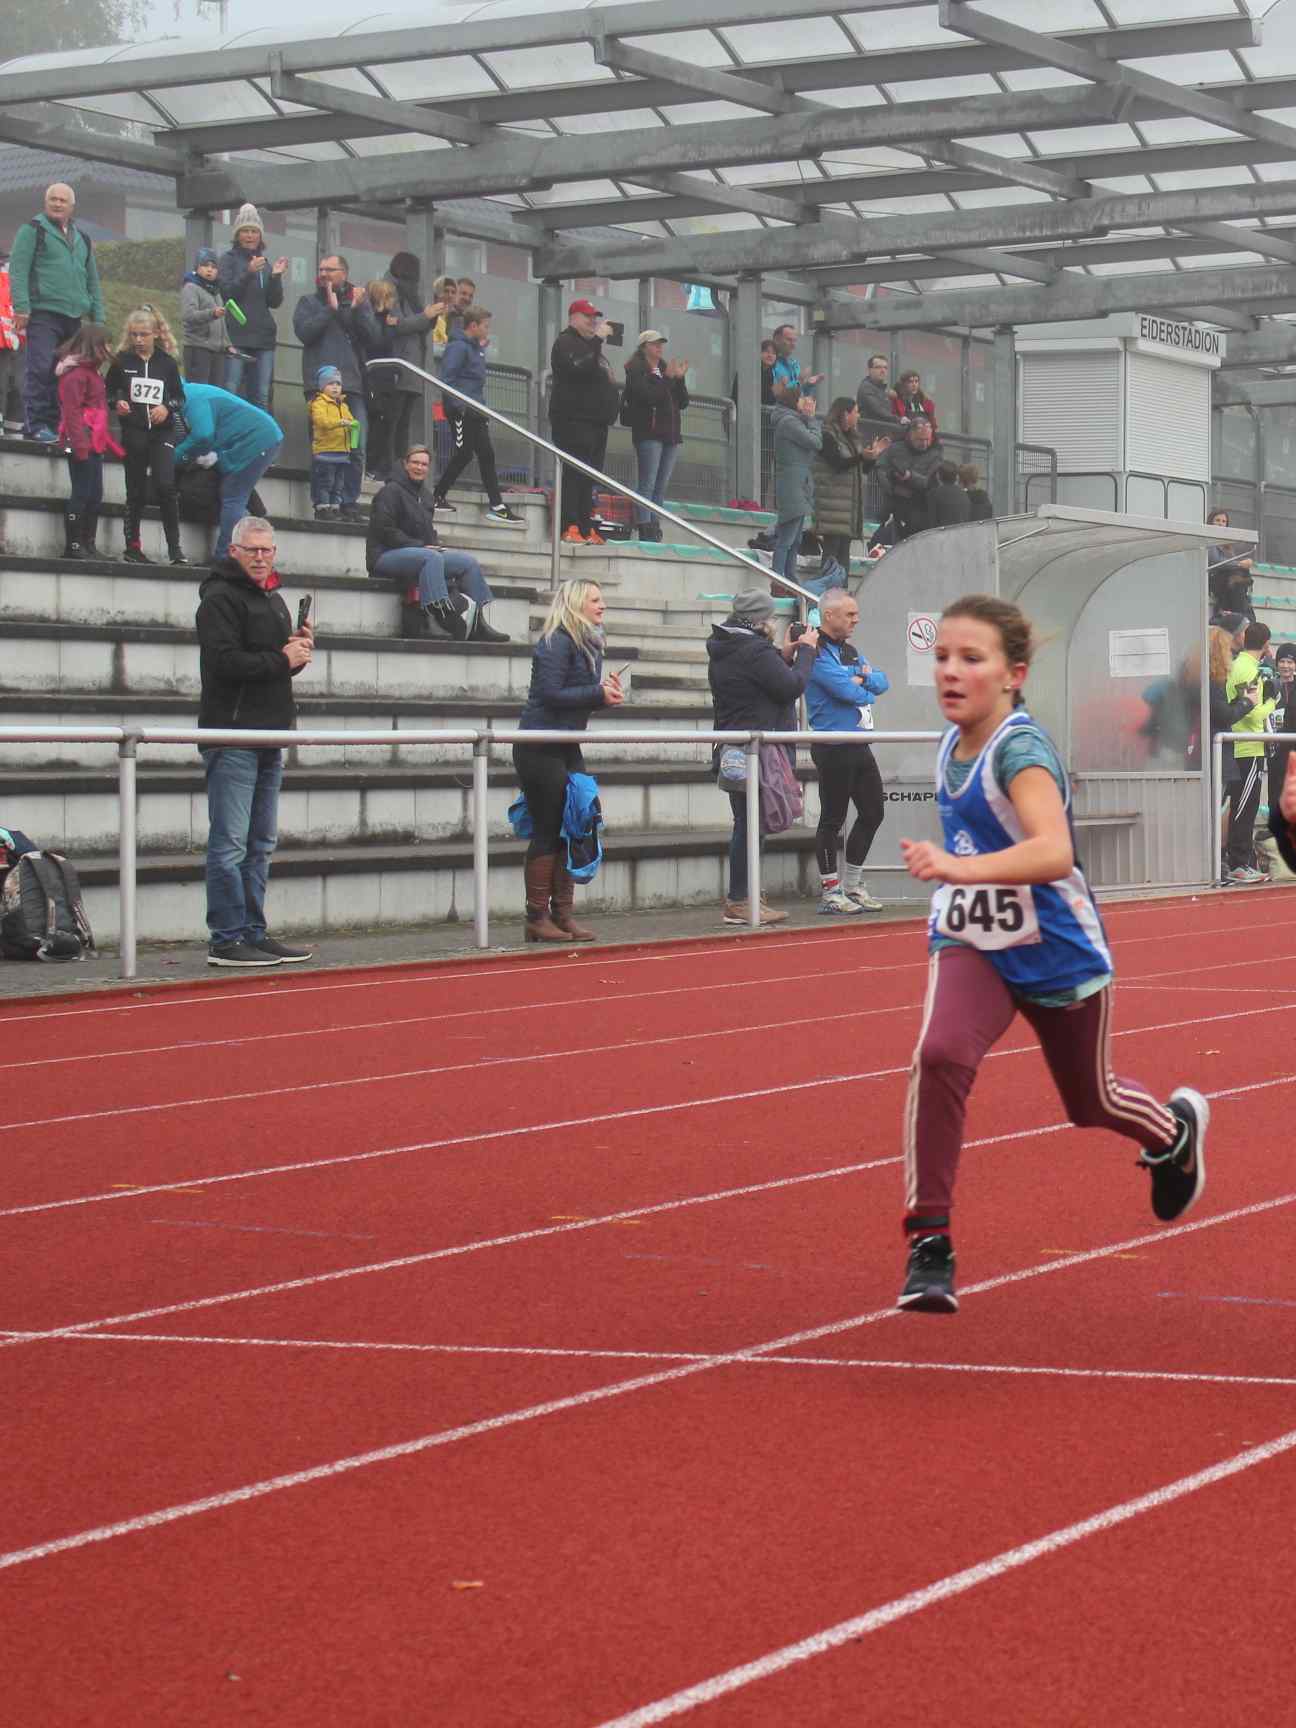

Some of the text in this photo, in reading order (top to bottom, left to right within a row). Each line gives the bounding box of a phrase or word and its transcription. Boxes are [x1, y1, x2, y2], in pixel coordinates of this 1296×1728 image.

[1140, 316, 1219, 354] EIDERSTADION
[133, 383, 161, 400] 372
[946, 888, 1024, 932] 645
